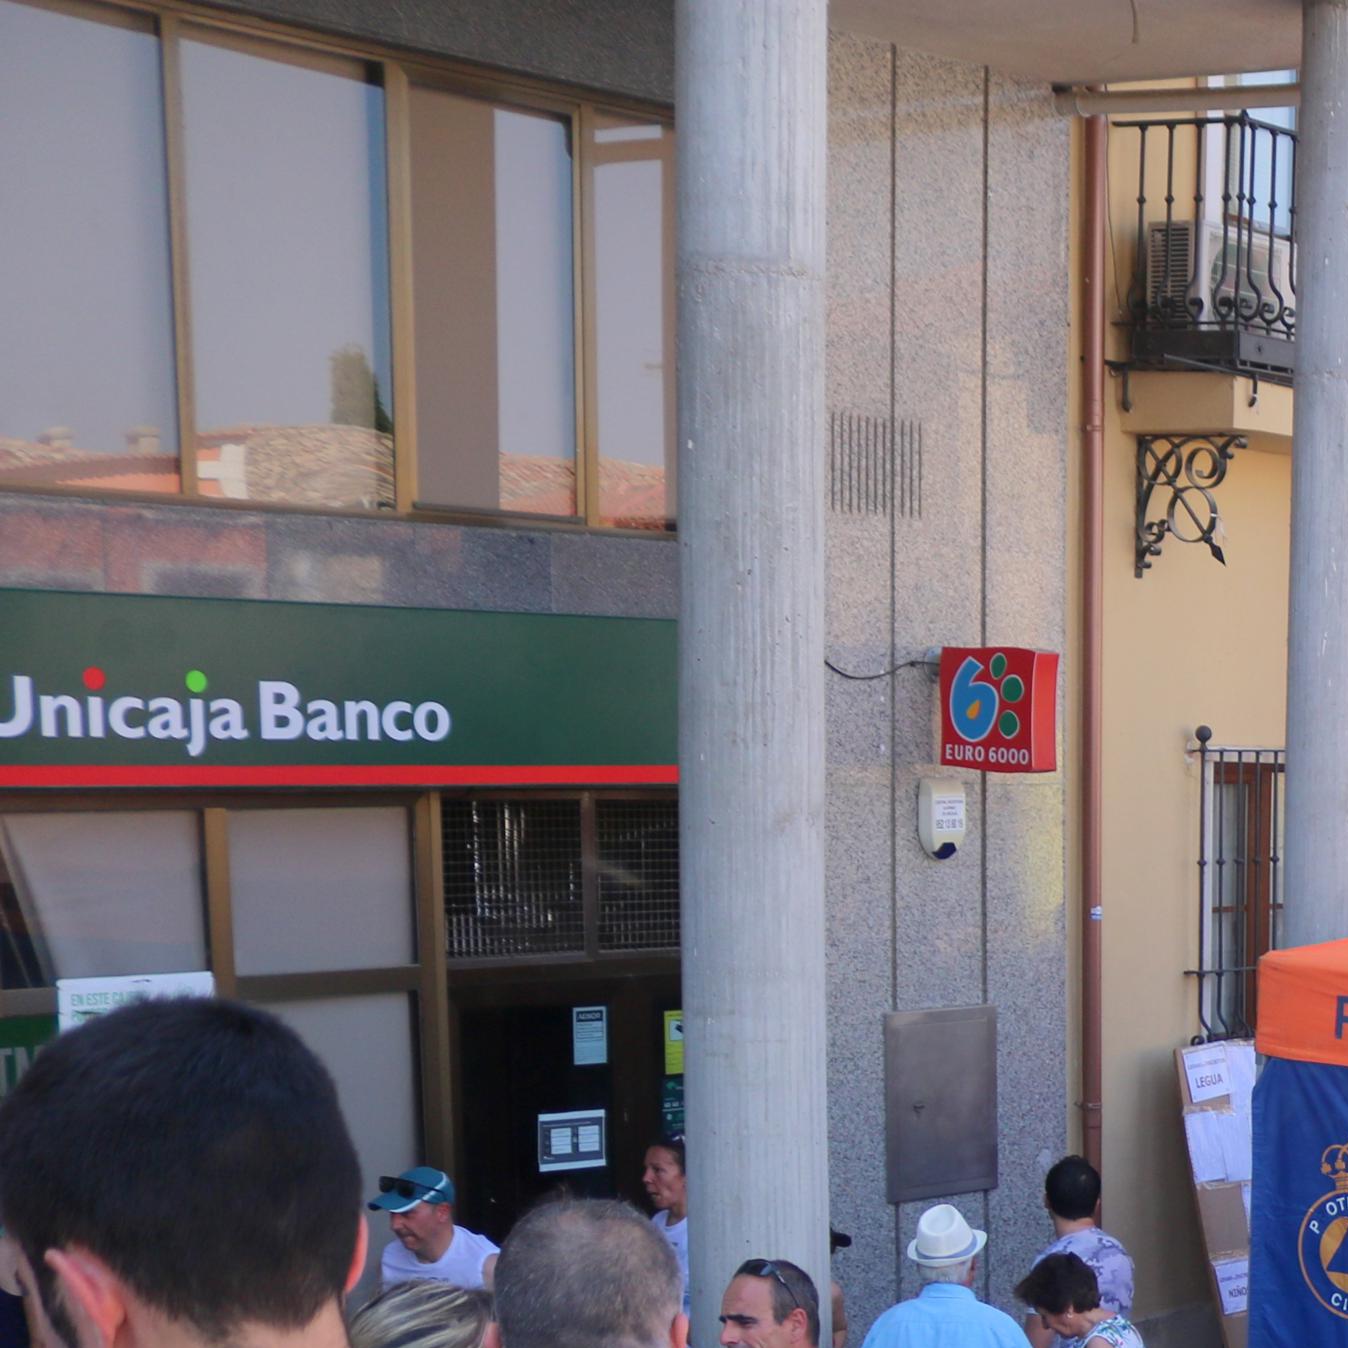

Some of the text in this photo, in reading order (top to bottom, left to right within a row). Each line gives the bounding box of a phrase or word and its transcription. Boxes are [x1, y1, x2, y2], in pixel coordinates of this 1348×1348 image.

[258, 680, 451, 742] Banco
[945, 743, 1029, 765] EURO 6000
[1194, 1073, 1224, 1089] LEGUA
